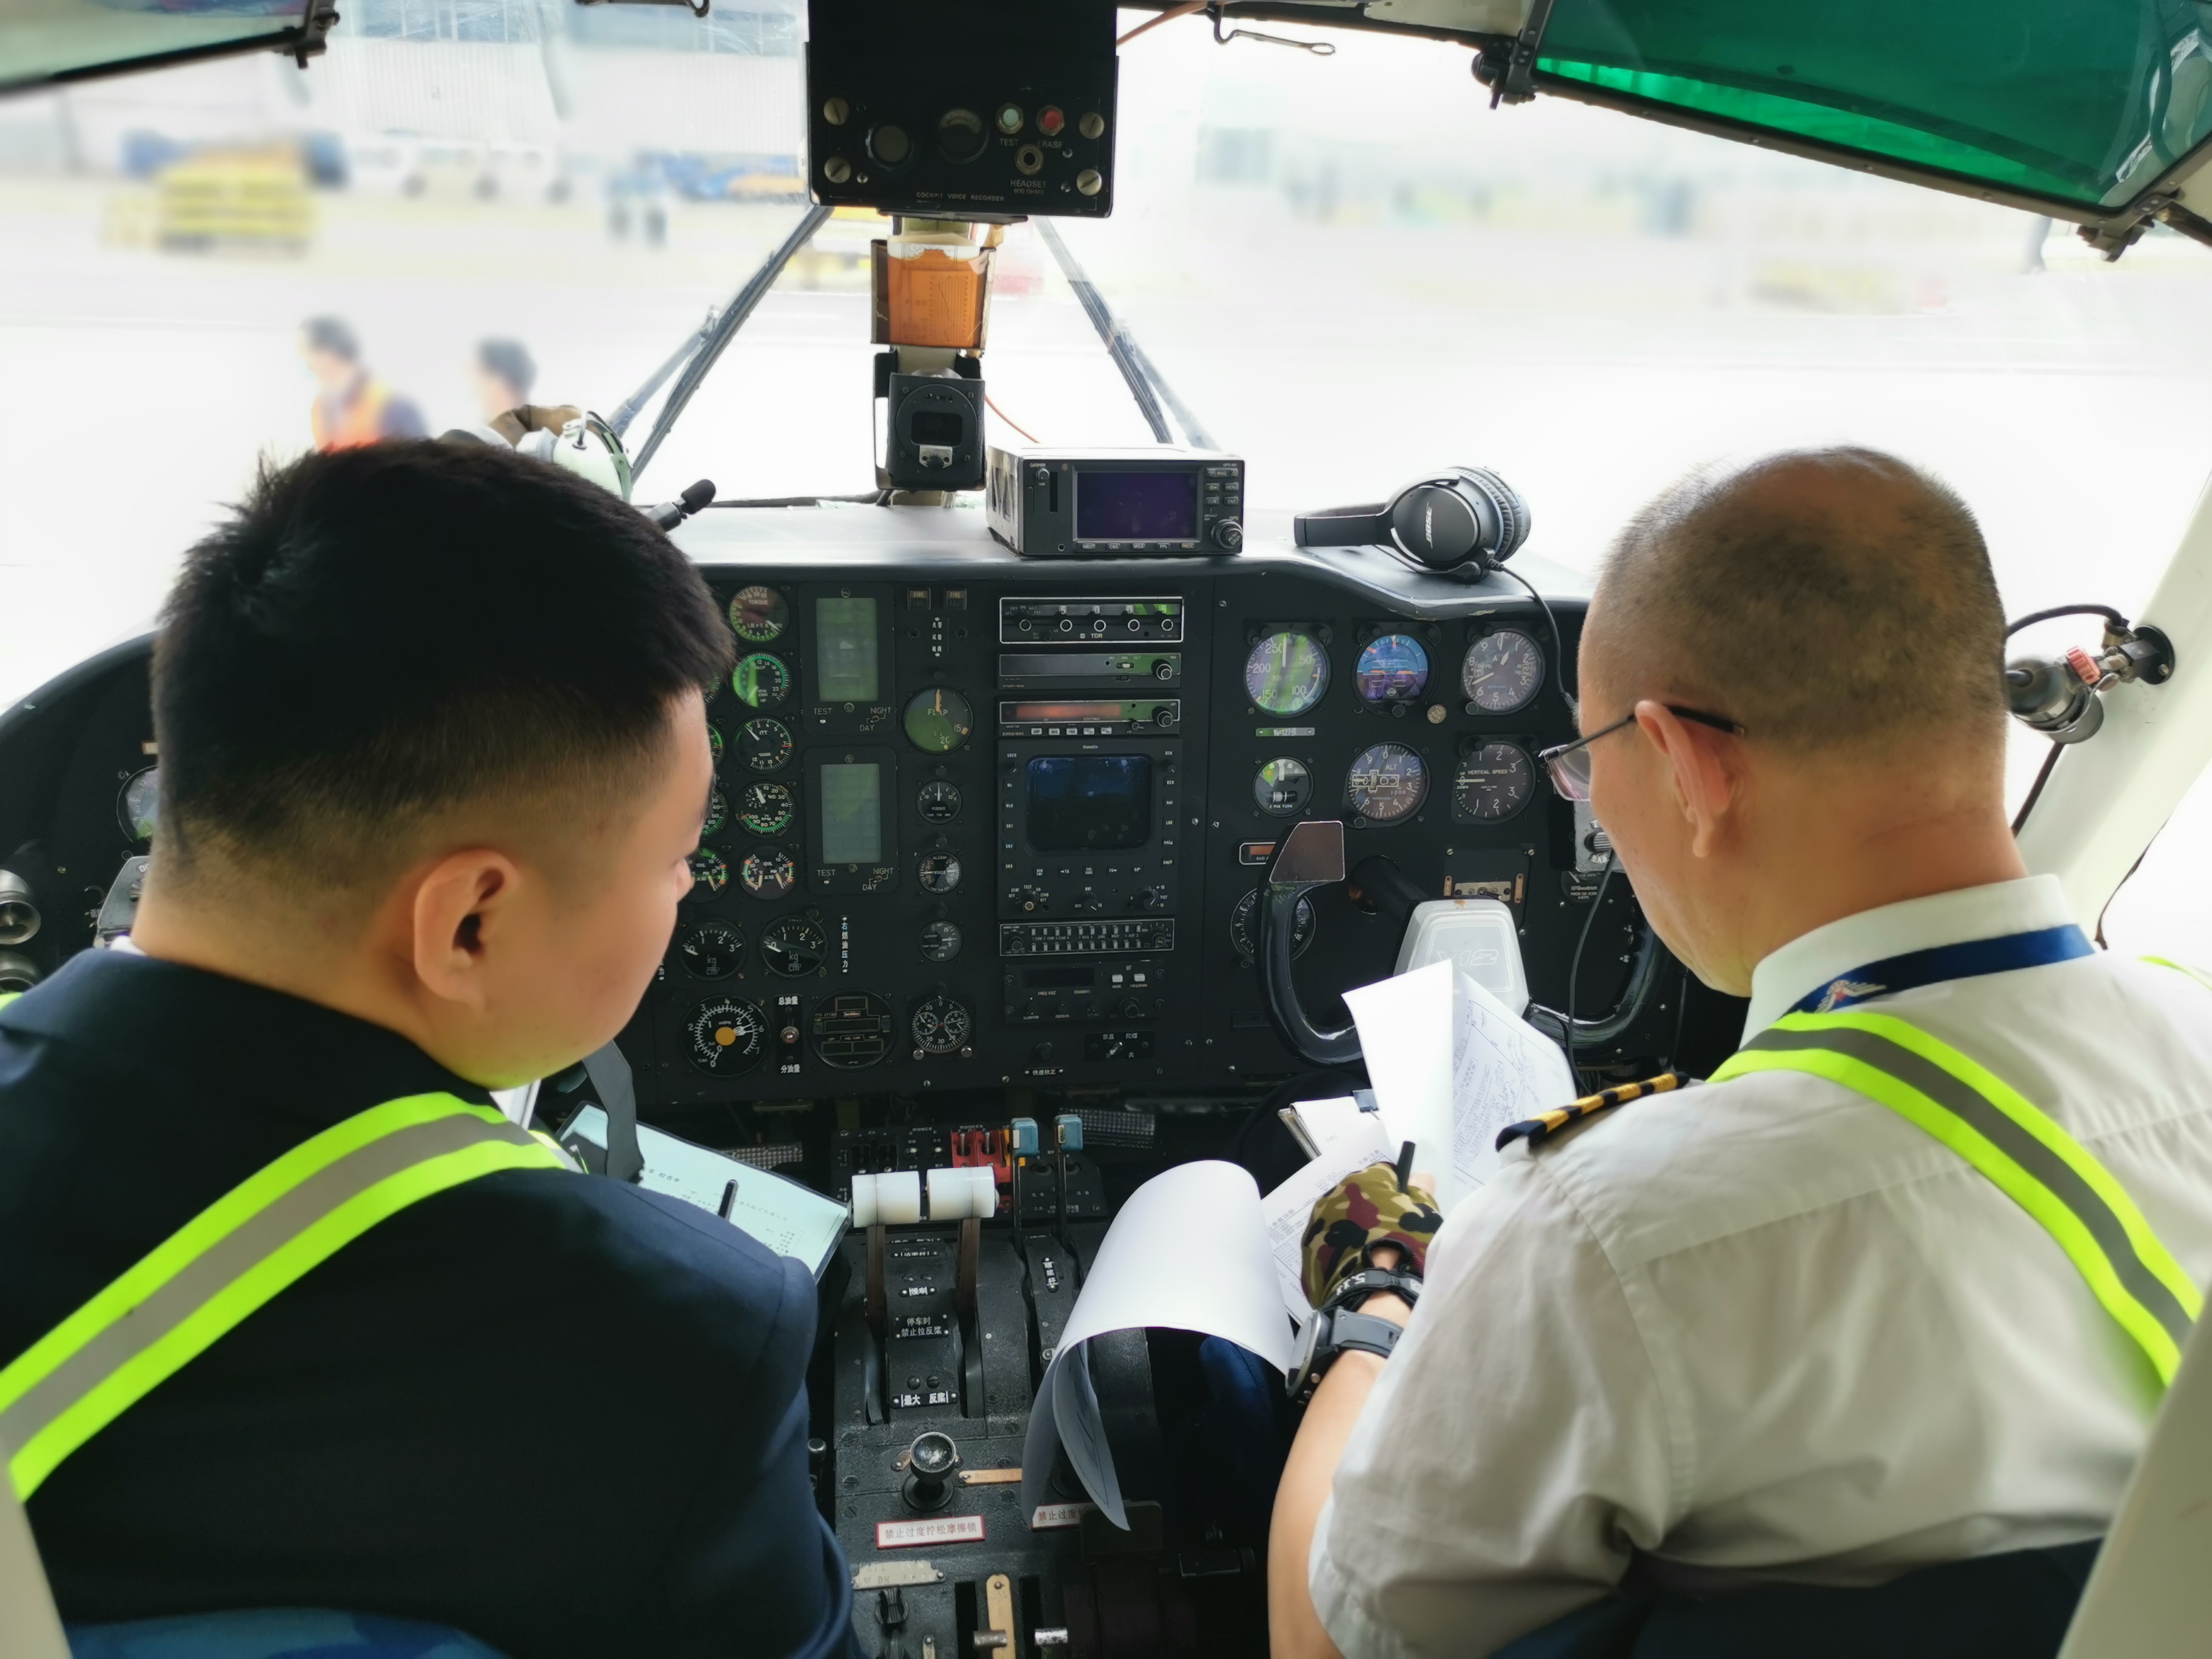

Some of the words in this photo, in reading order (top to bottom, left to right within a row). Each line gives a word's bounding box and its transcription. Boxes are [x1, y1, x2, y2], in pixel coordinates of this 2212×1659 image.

[999, 138, 1019, 147] TEST
[1010, 179, 1047, 188] HEADSET
[970, 193, 1005, 202] RECORDER
[1265, 643, 1283, 654] 250
[1481, 642, 1488, 652] 9
[1299, 655, 1312, 665] 50
[1252, 663, 1272, 674] 200
[1520, 675, 1527, 686] 3
[1262, 689, 1278, 700] 150
[1292, 685, 1307, 695] 100
[1476, 686, 1484, 697] 6
[1509, 687, 1515, 697] 4
[1492, 692, 1500, 702] 5
[814, 707, 833, 716] TEST
[870, 706, 892, 715] NIGHT
[954, 723, 962, 732] 15
[1496, 751, 1503, 761] 2
[1509, 763, 1517, 773] 3
[1507, 786, 1515, 797] 3
[1493, 799, 1500, 809] 2
[1590, 854, 1607, 864] RAD
[817, 868, 836, 877] TEST
[873, 866, 894, 875] NIGHT
[718, 936, 725, 945] 2
[799, 933, 806, 941] 2
[810, 940, 816, 949] 3
[707, 954, 717, 967] kg
[789, 950, 799, 964] kg
[777, 996, 799, 1006] 总油量
[687, 1023, 695, 1031] 2
[759, 1025, 765, 1033] 6
[780, 1064, 800, 1074] 分油量
[658, 1172, 680, 1183] 检查单
[1336, 1272, 1366, 1296] 5.11
[907, 1316, 931, 1327] 停车时
[901, 1326, 942, 1337] 禁止拉反桨
[903, 1394, 921, 1406] 最大
[929, 1392, 946, 1404] 反桨
[885, 1522, 977, 1539] 禁止过度拧松摩擦锁
